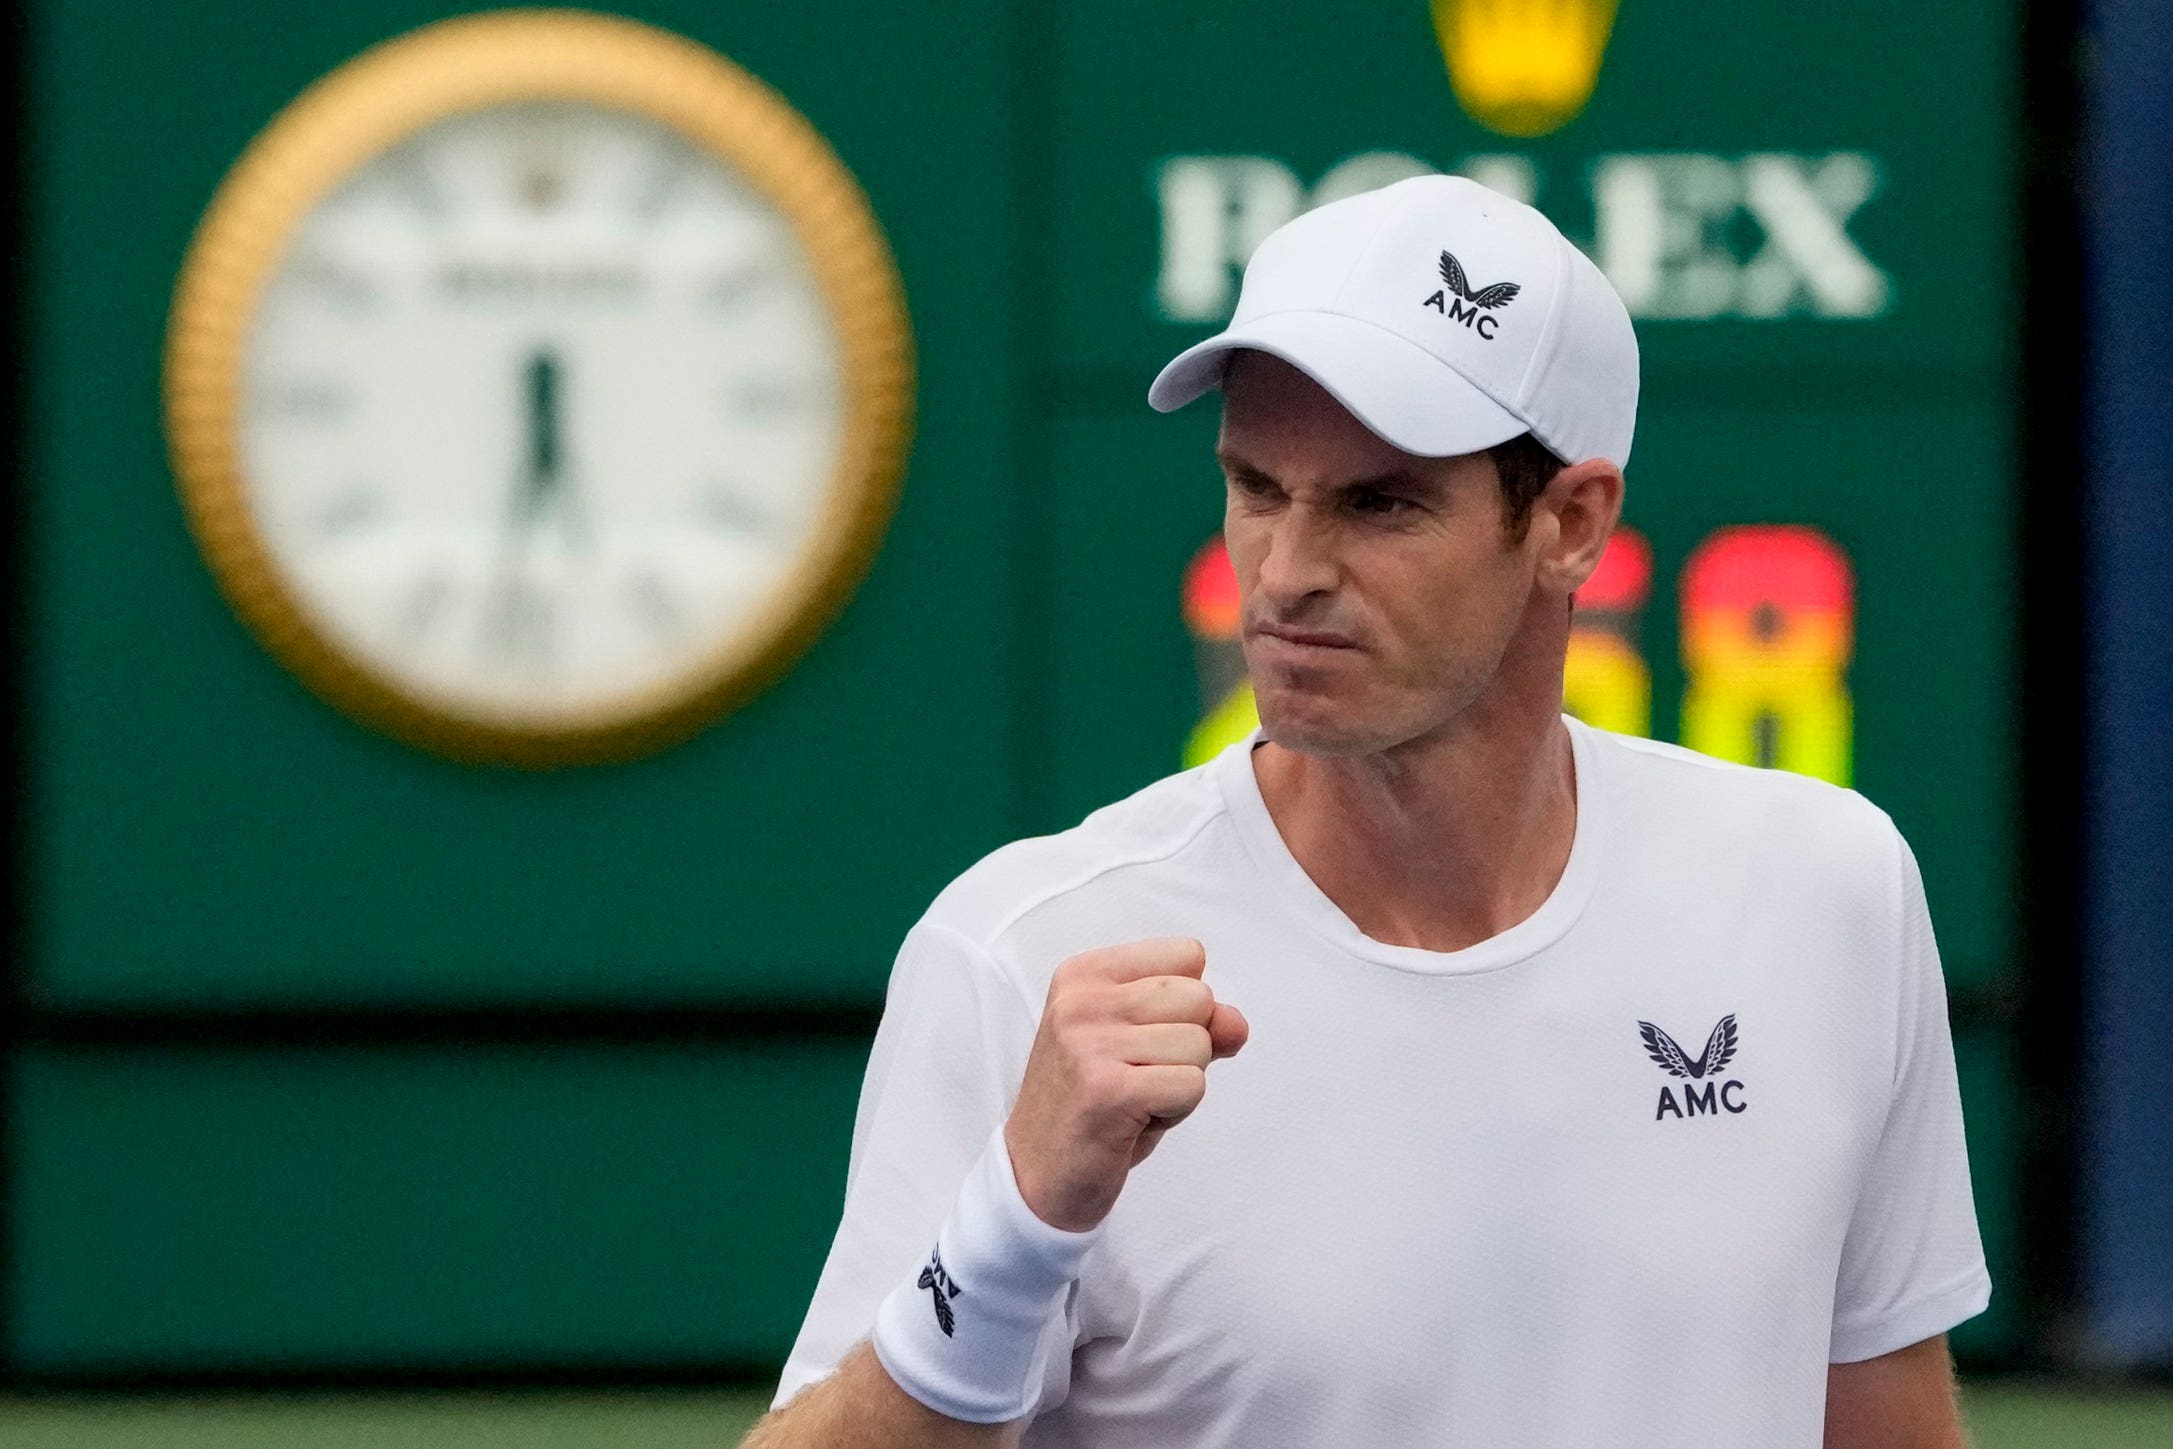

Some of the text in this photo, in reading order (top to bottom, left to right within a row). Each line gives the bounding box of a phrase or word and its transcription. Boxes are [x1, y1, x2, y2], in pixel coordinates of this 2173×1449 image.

[1155, 151, 1886, 320] REX
[1423, 289, 1499, 340] AMC
[1656, 1080, 1748, 1121] AMC
